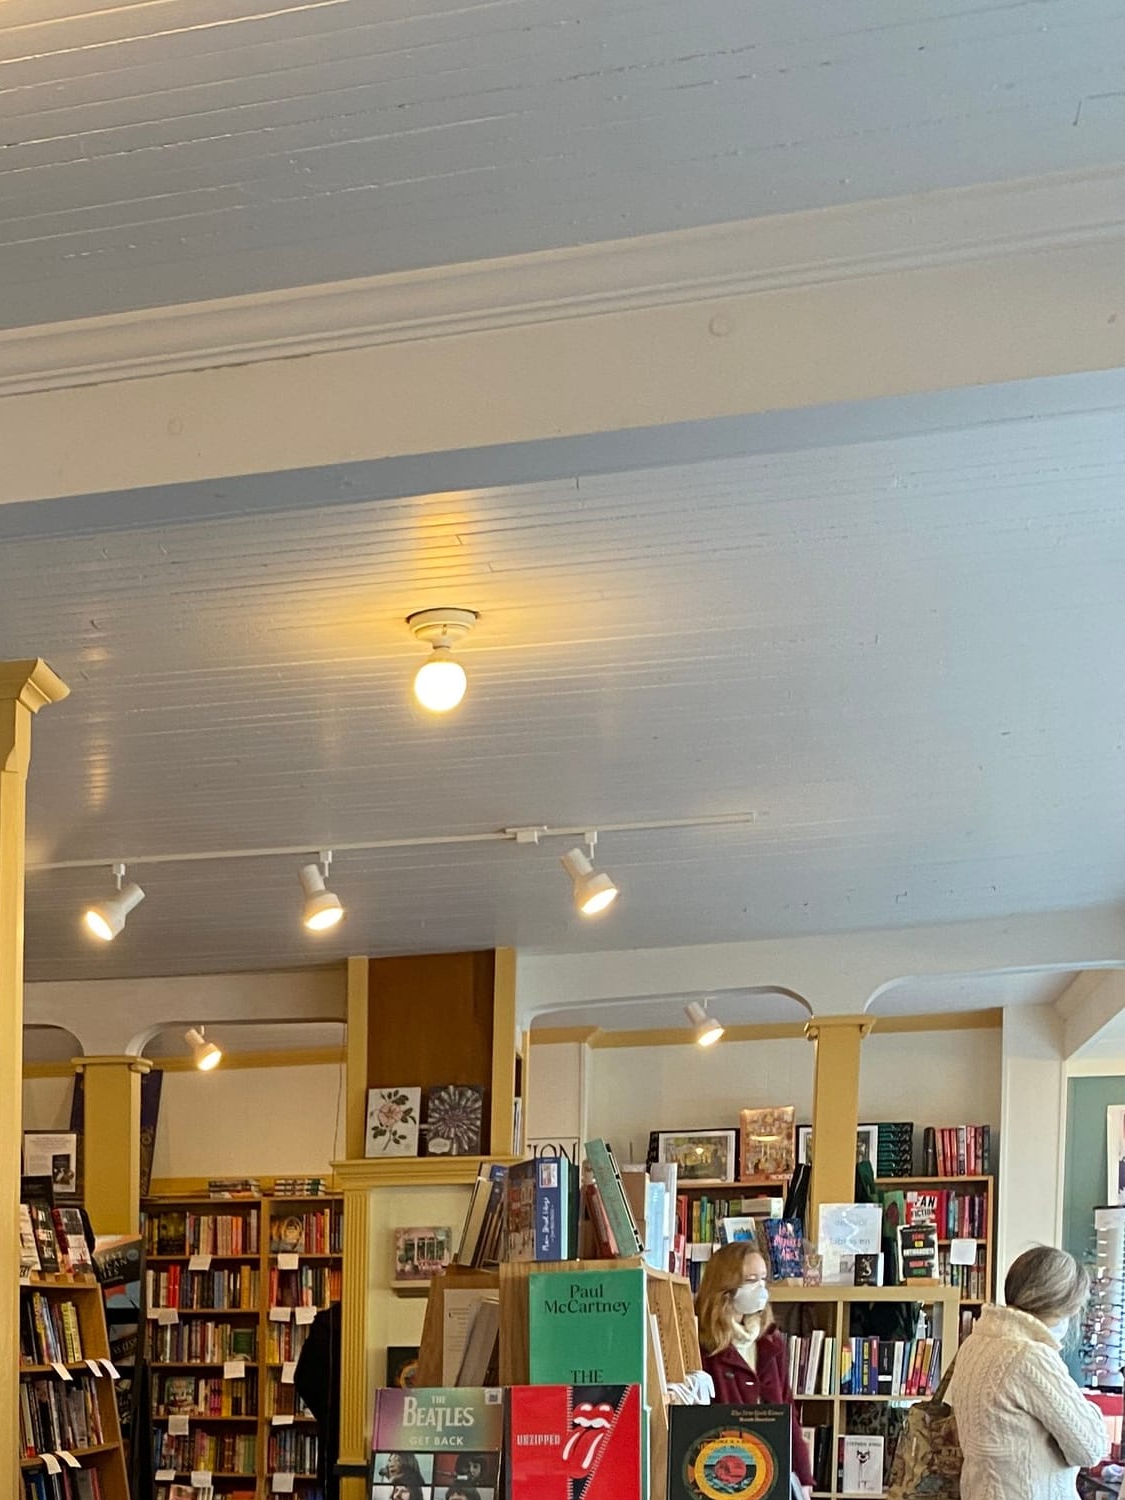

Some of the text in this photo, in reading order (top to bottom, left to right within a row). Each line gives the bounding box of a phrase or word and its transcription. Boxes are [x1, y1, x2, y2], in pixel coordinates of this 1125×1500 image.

[569, 1284, 605, 1299] Paul
[543, 1299, 631, 1316] McCartney
[571, 1368, 604, 1384] THE
[402, 1396, 475, 1432] BEATLES
[408, 1435, 465, 1447] GET BACK
